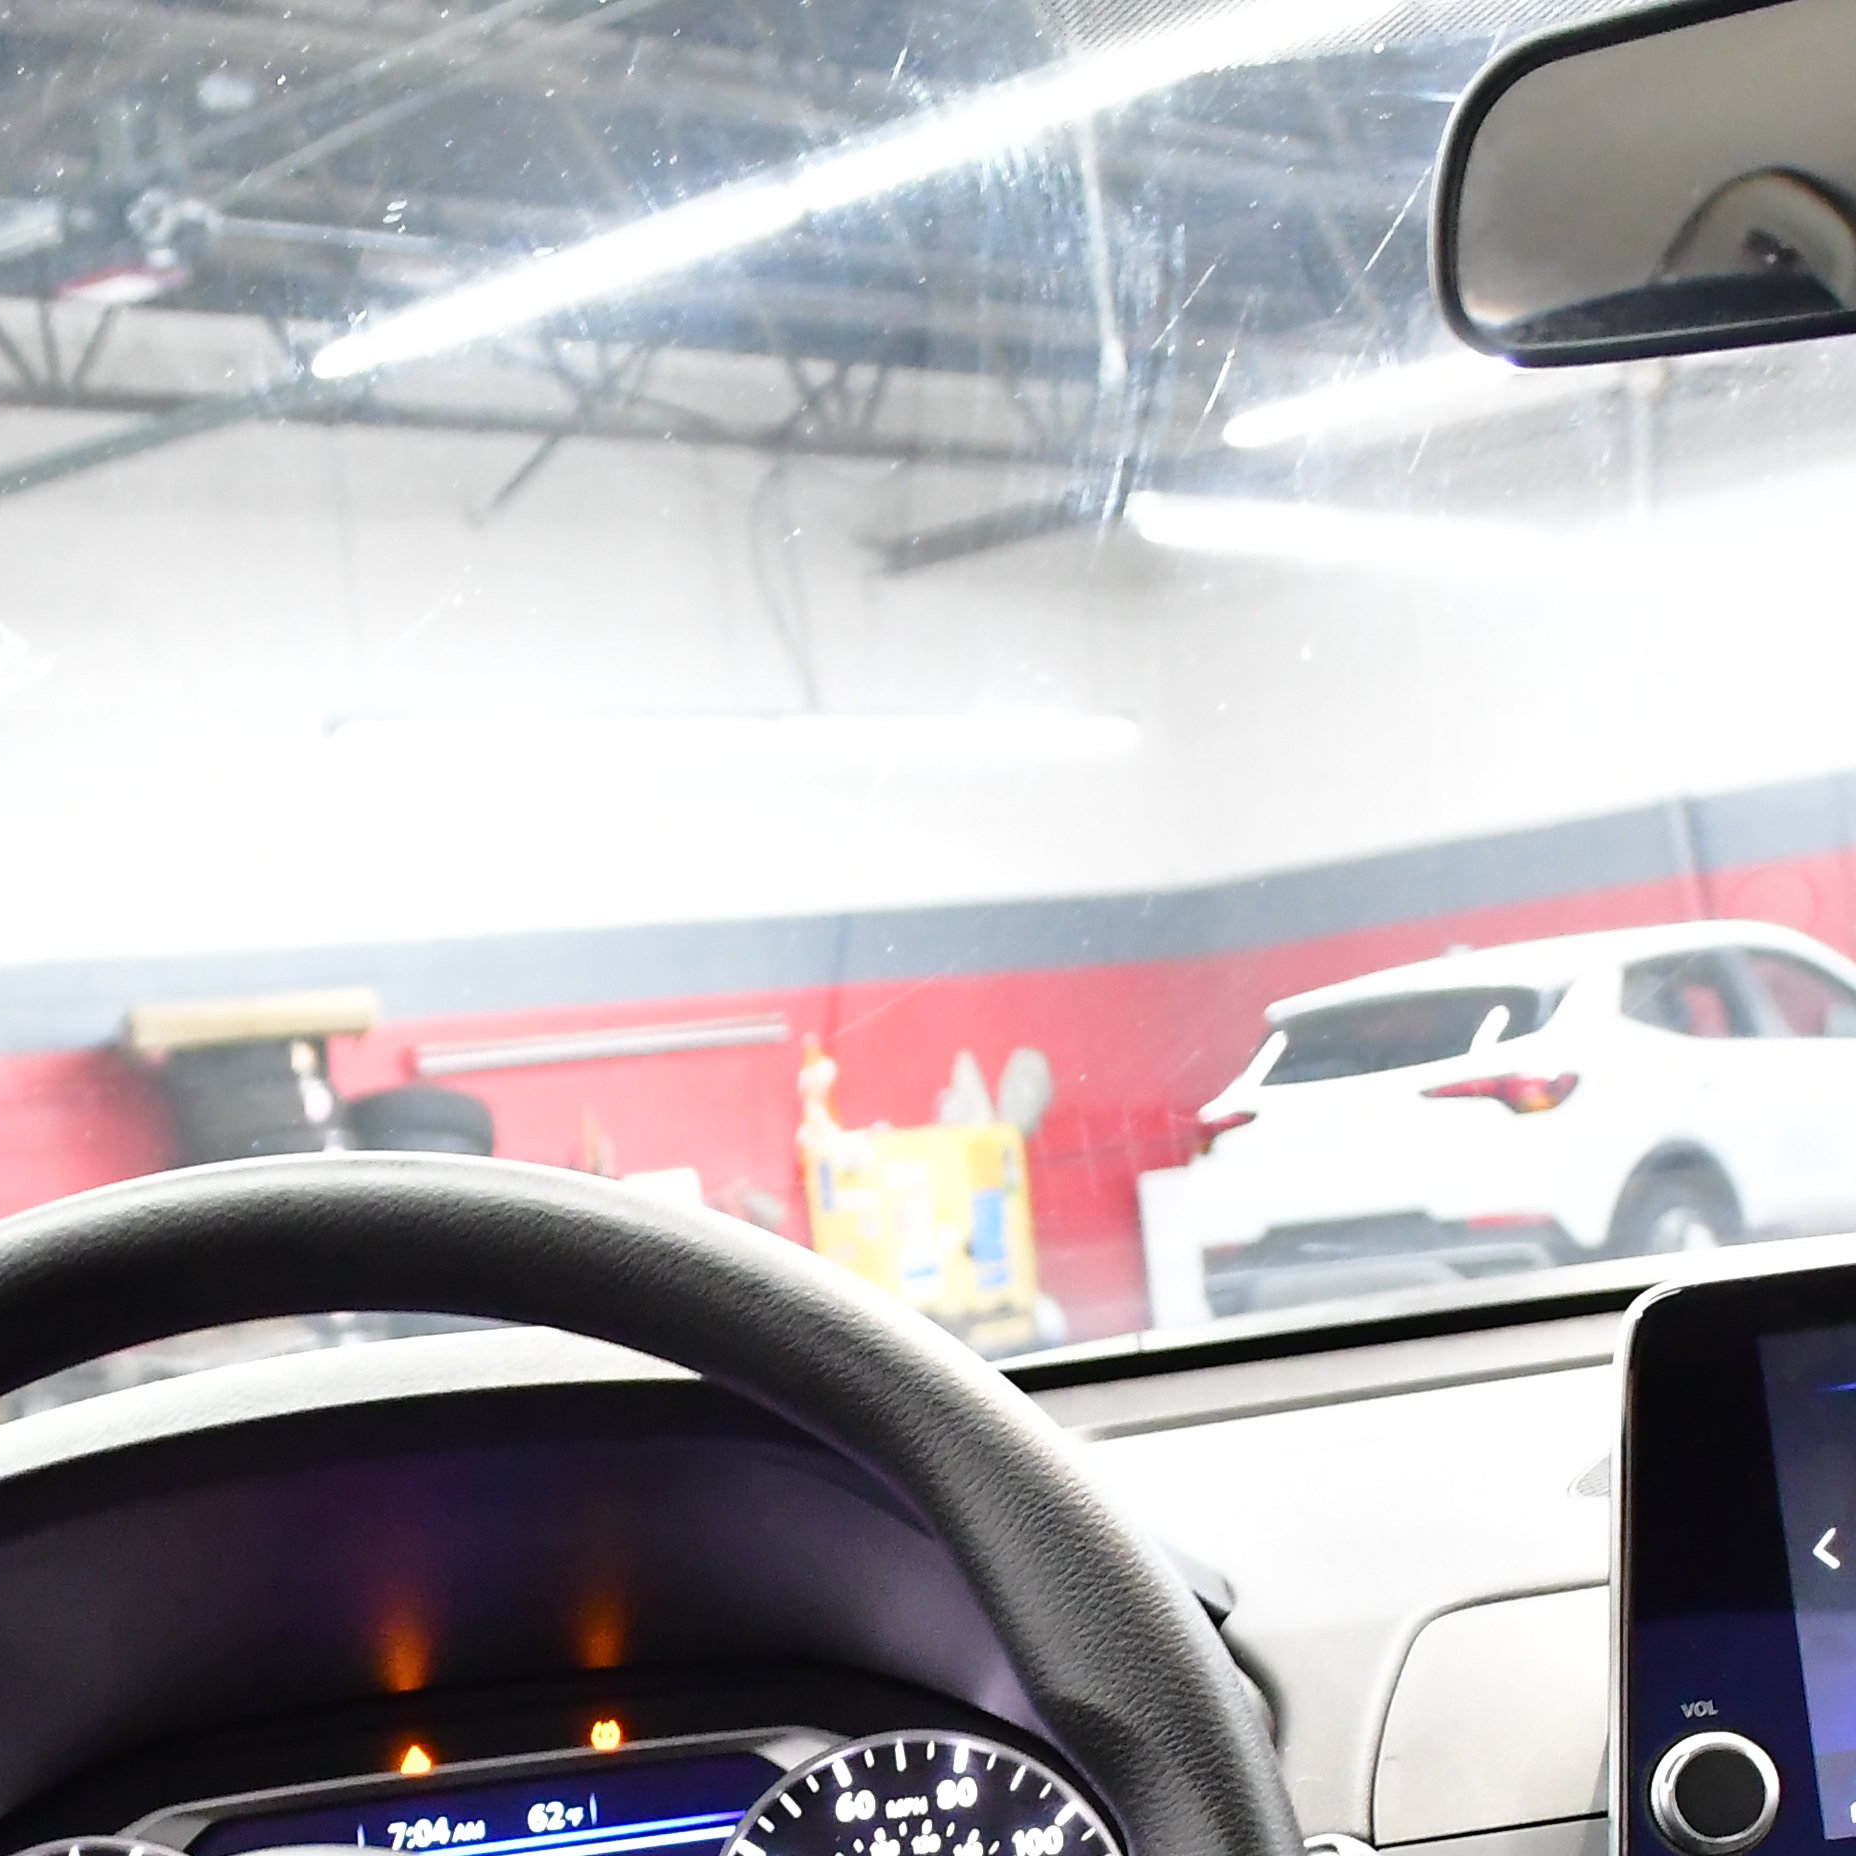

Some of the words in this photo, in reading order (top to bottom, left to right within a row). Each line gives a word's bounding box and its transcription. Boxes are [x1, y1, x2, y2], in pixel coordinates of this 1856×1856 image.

[1680, 1700, 1719, 1719] VOL
[835, 1790, 876, 1822] 60
[885, 1795, 928, 1819] MPH
[936, 1776, 978, 1810] 80
[387, 1817, 450, 1851] 7:04
[452, 1820, 486, 1843] AM
[1012, 1825, 1064, 1856] 100
